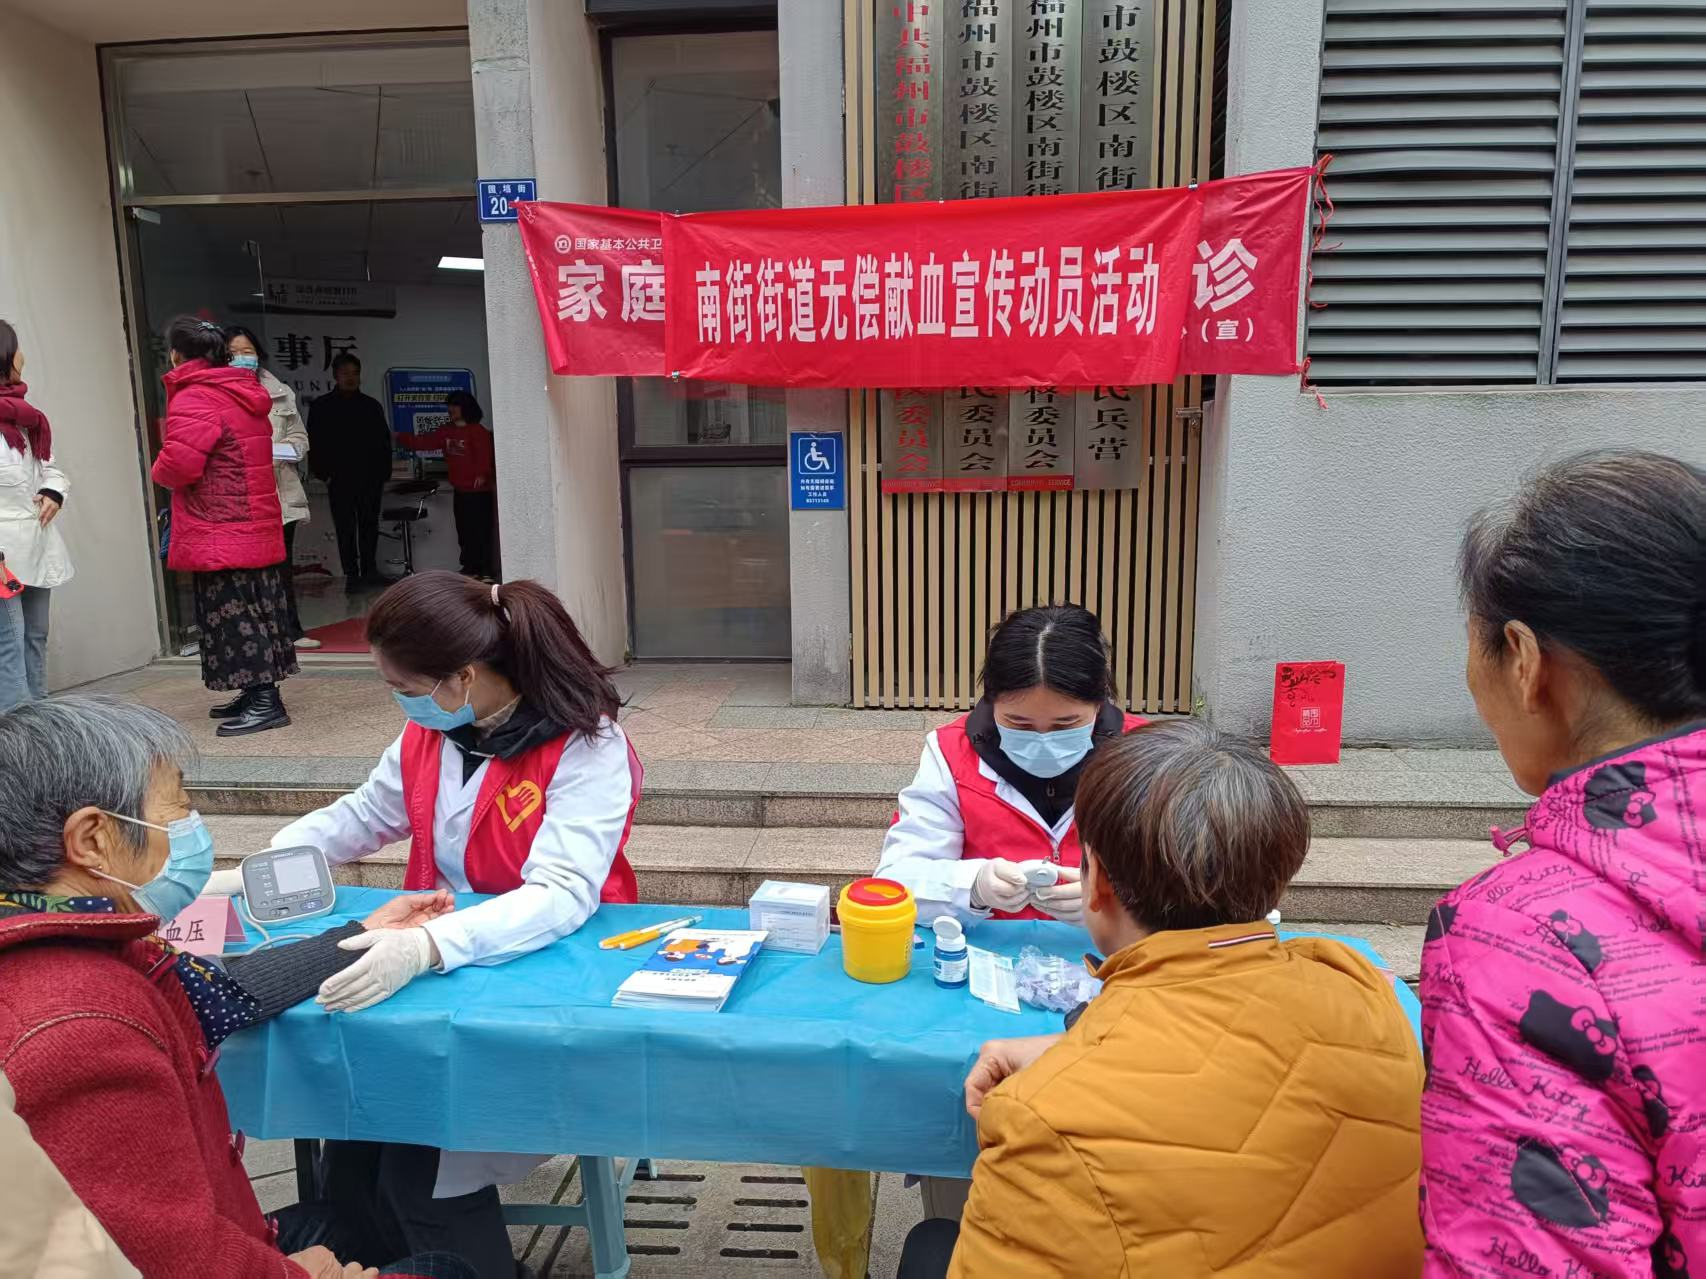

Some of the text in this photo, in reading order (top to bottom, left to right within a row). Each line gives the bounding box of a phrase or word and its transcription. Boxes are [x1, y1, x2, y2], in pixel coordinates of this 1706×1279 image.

[1096, 4, 1142, 190] 市鼓楼区南街
[574, 237, 663, 251] 国家基本公共卫
[557, 238, 1258, 323] 家庭 诊
[696, 243, 1159, 344] 南街街道无偿献血宣传动员活动
[1181, 317, 1254, 342] （宣）
[152, 919, 205, 943] 血压
[1482, 1236, 1551, 1276] Hello
